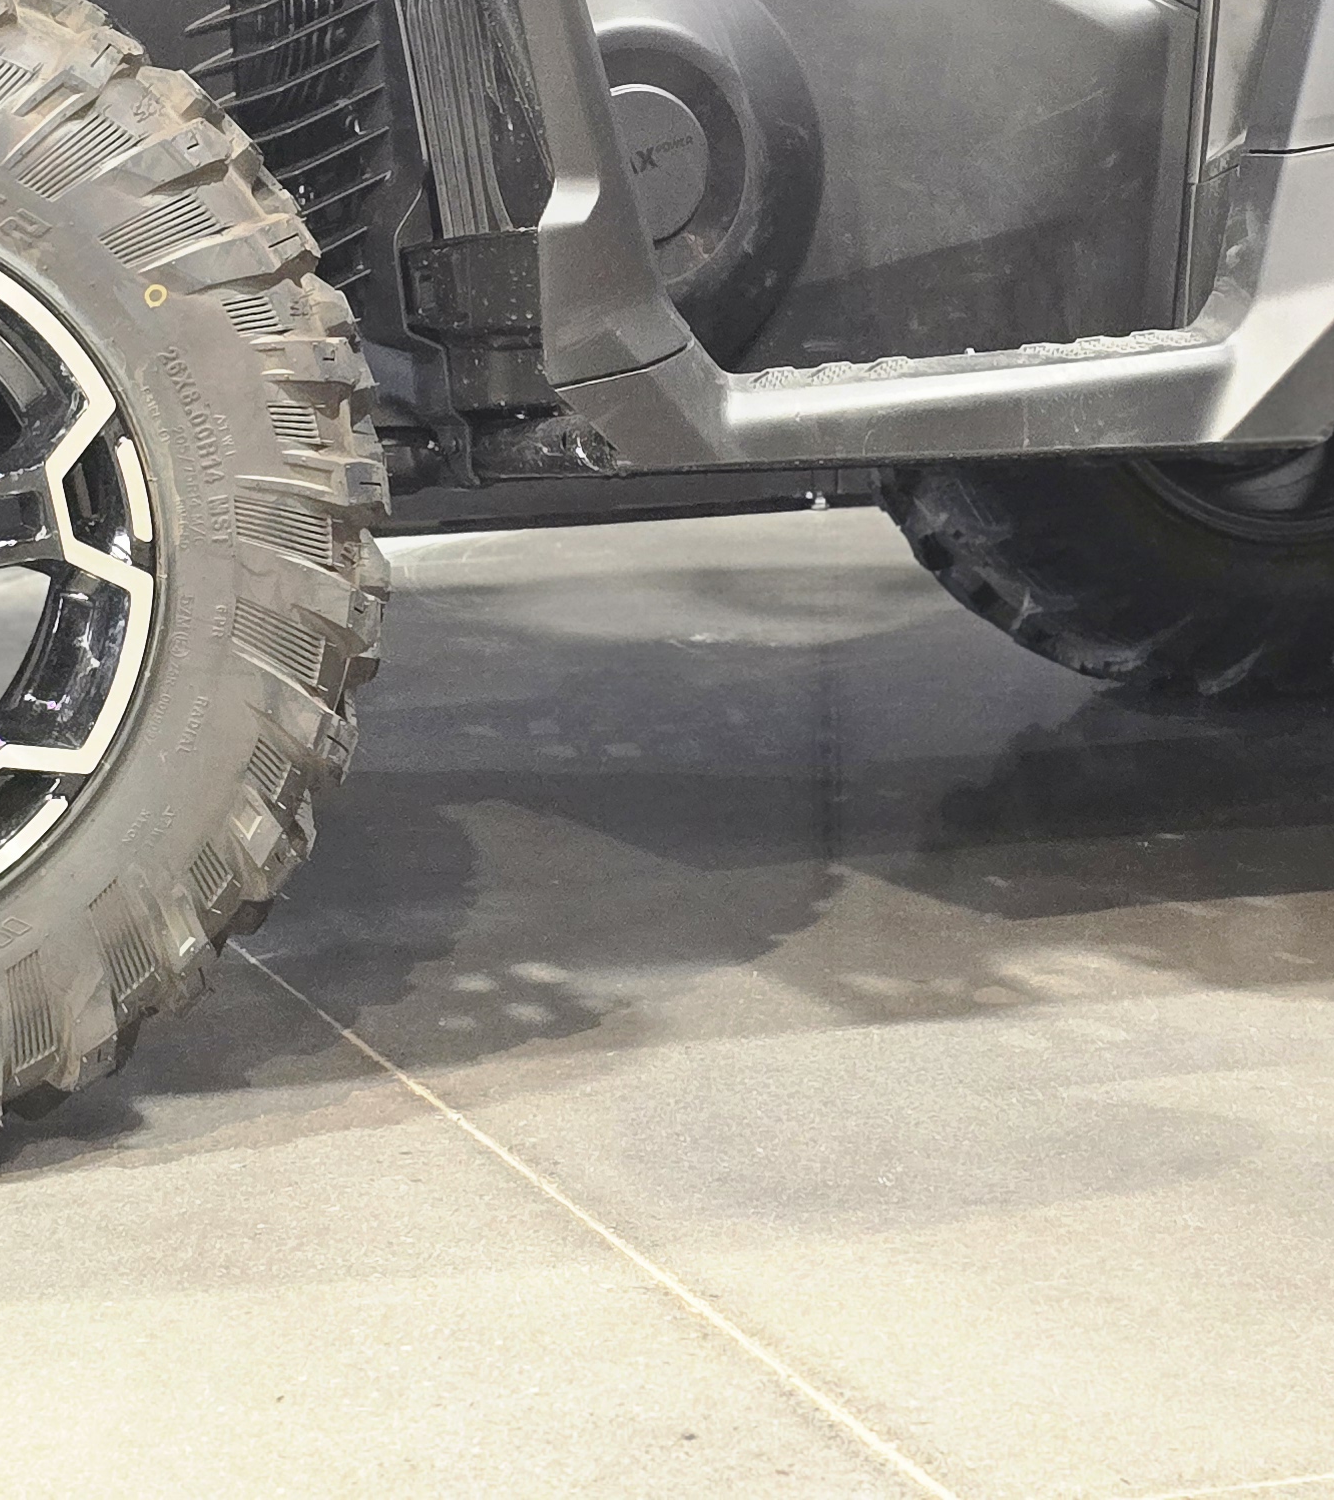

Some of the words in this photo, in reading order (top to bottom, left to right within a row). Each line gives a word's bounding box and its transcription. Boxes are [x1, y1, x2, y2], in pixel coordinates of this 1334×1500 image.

[155, 342, 228, 485] 26X8.00R14
[204, 493, 234, 549] MST
[174, 693, 211, 759] RADIAL
